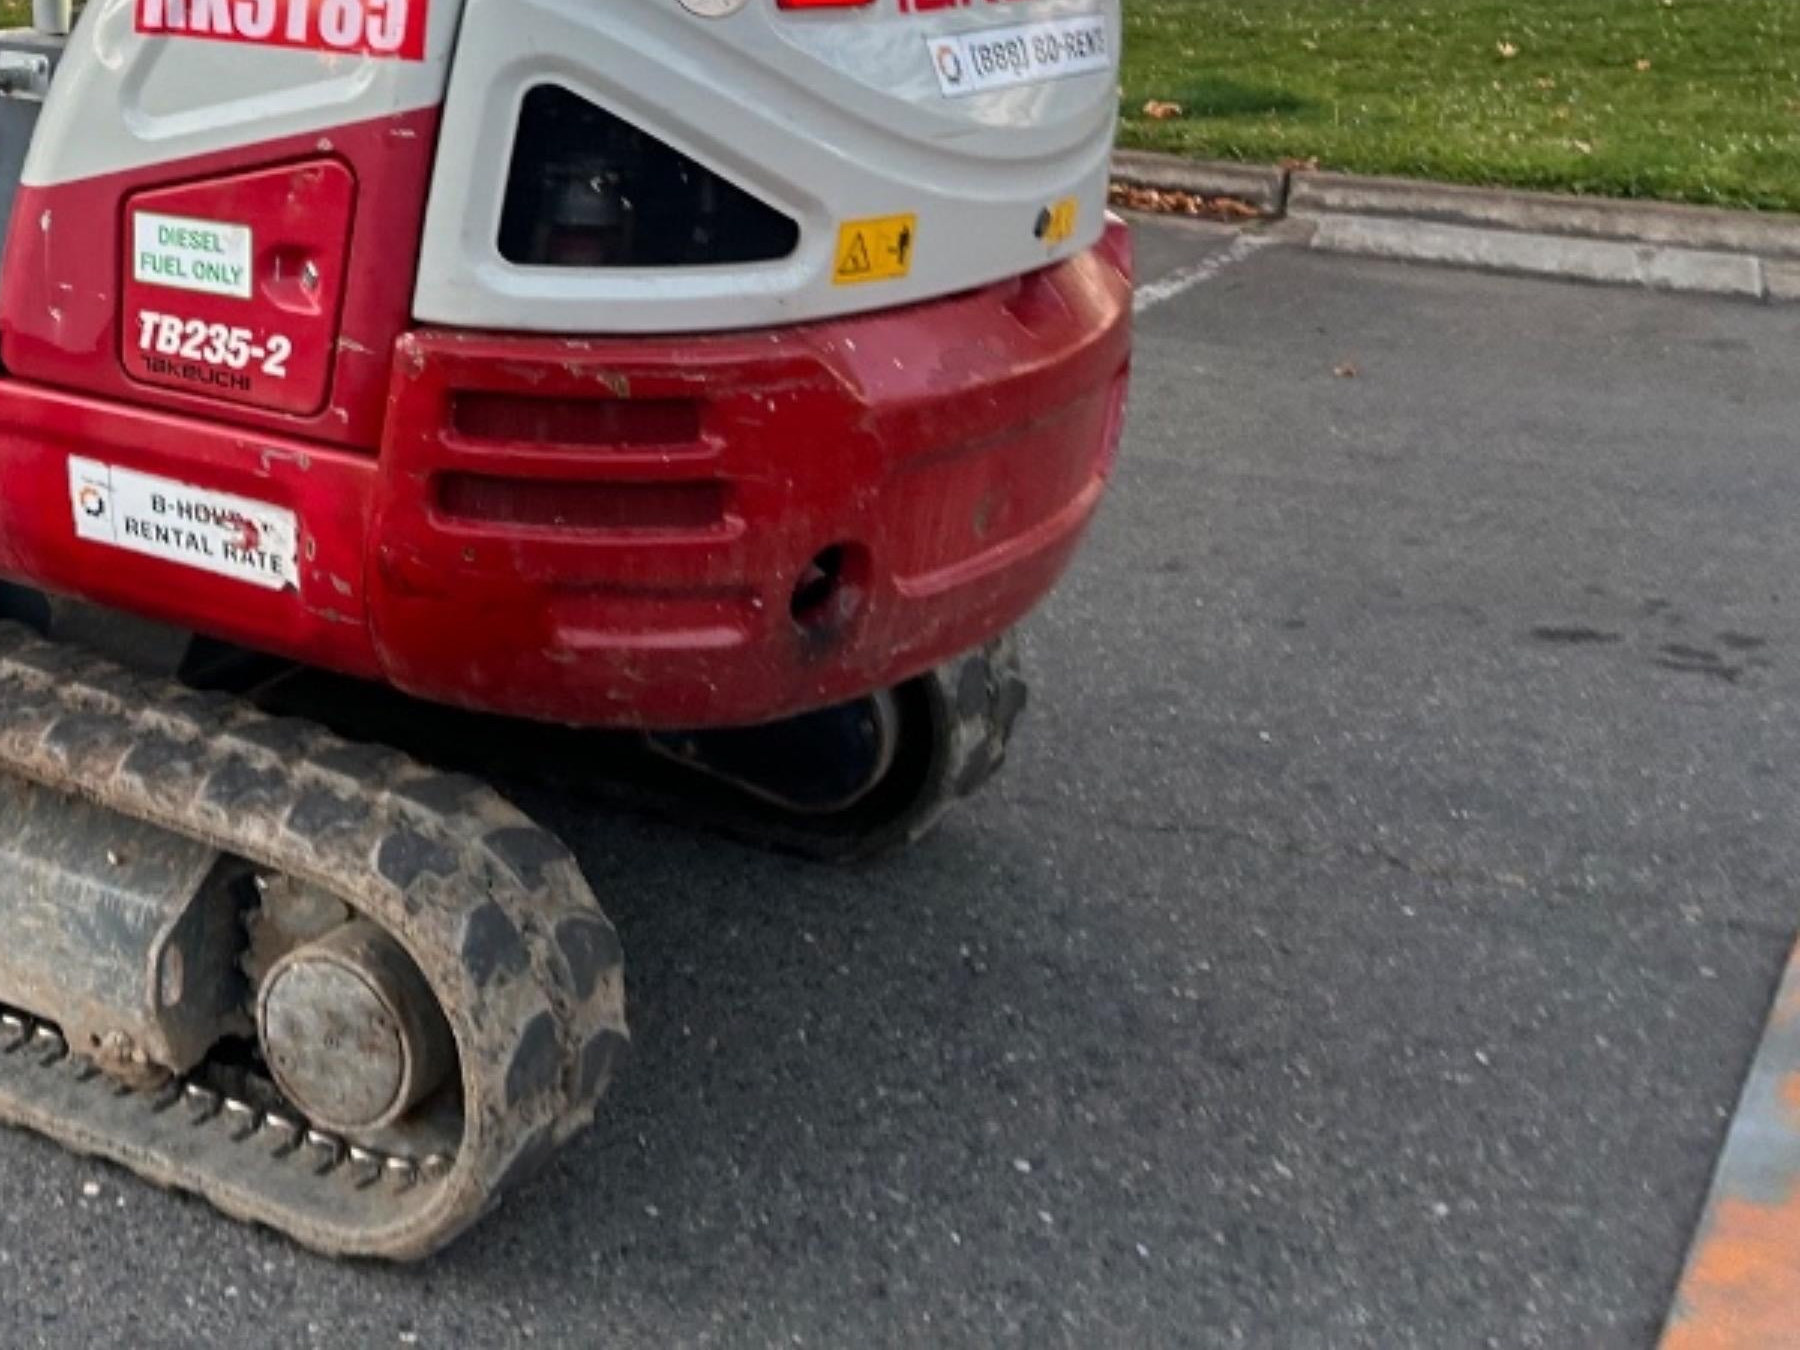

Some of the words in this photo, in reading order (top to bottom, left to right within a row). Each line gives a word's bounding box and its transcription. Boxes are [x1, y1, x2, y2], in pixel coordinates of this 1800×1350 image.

[158, 225, 224, 252] DIESEL
[141, 252, 185, 276] FUEL
[192, 259, 243, 286] ONLY
[138, 310, 292, 378] TB235-2
[125, 517, 214, 556] RENTAL
[223, 540, 282, 574] RATE
